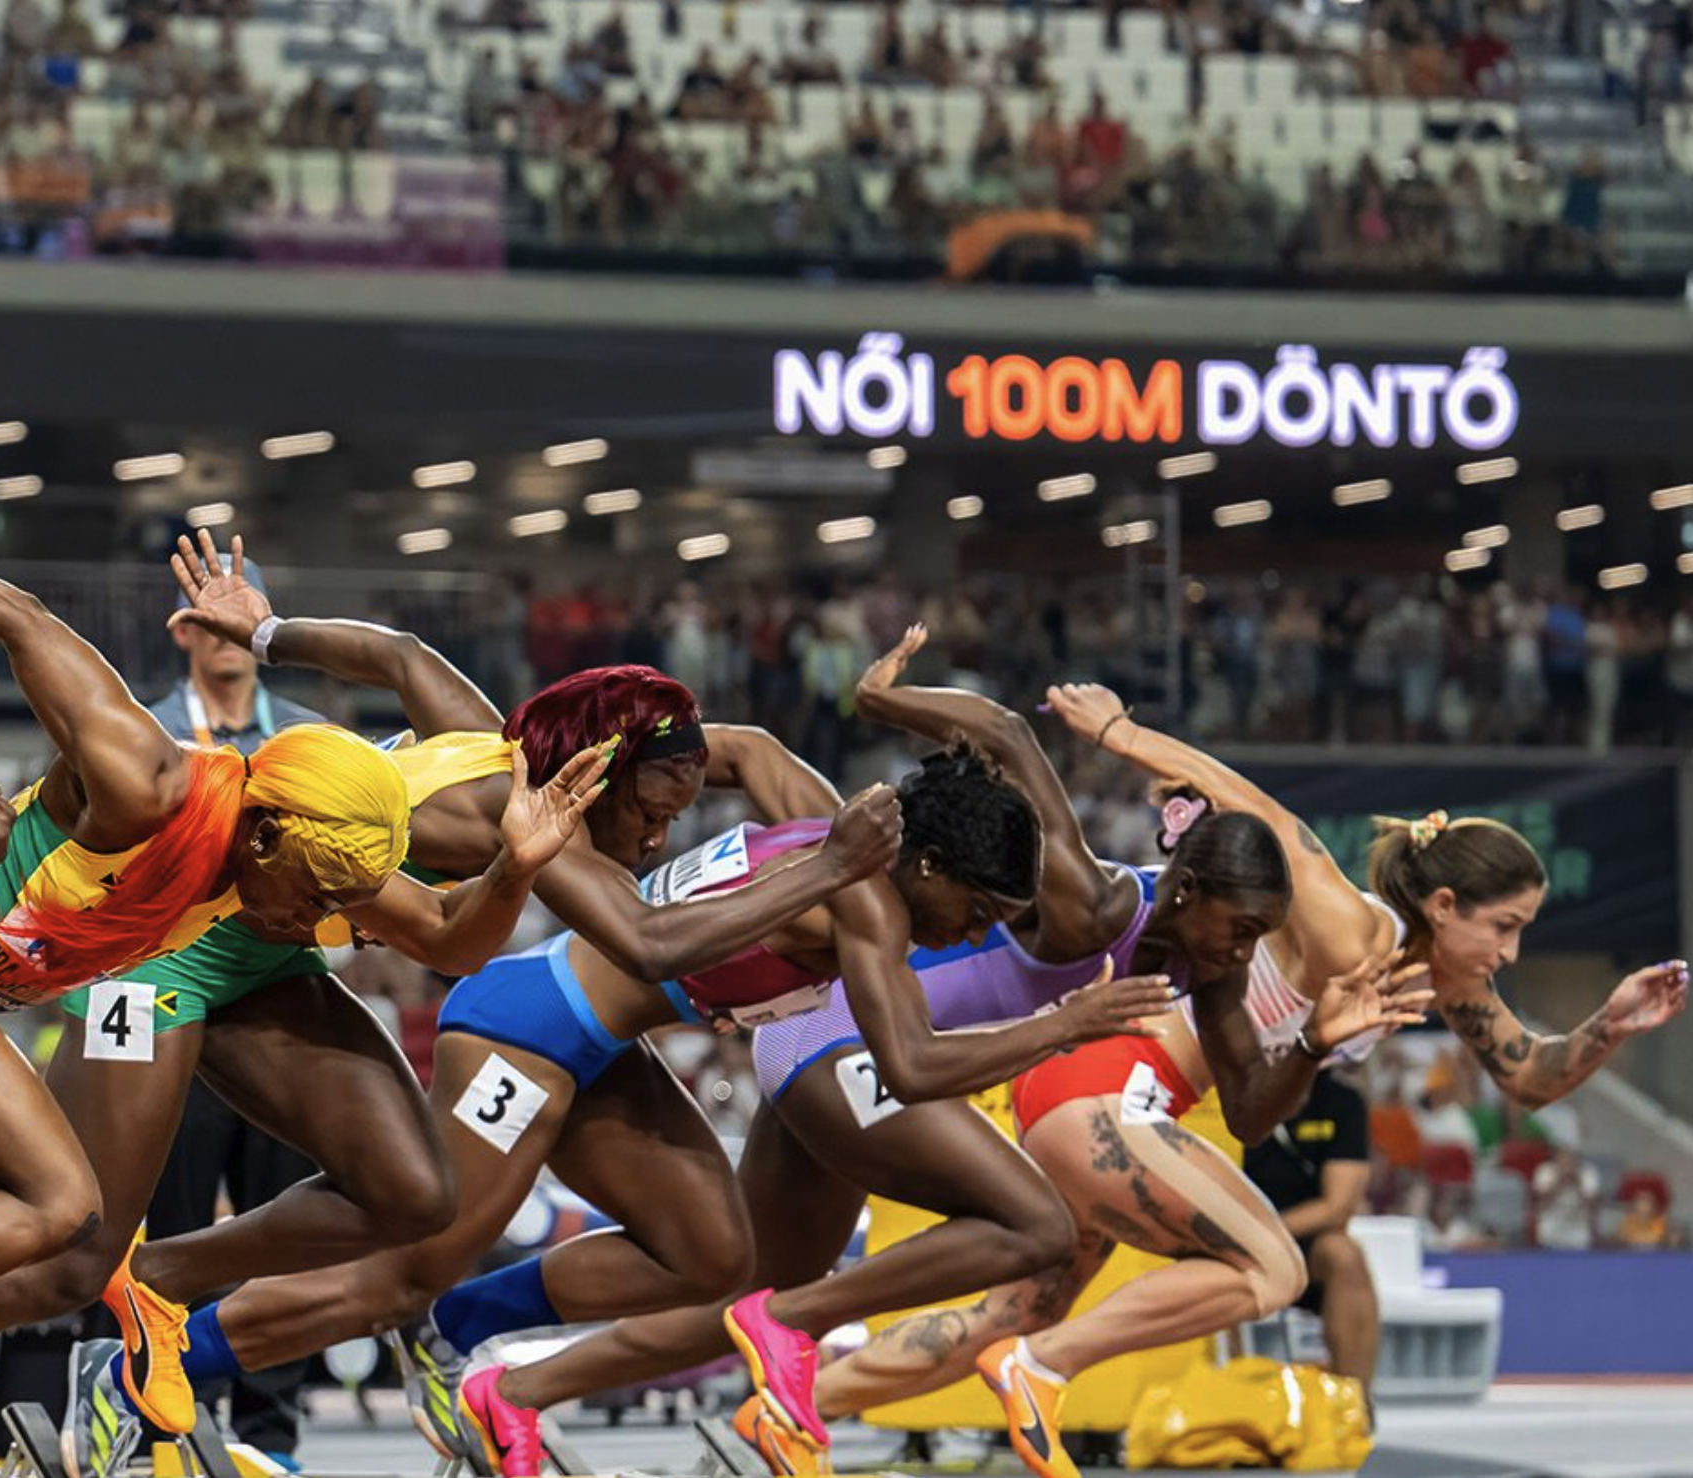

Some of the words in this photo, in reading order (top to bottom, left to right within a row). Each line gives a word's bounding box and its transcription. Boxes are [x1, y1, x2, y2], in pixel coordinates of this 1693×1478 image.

[774, 331, 935, 438] NŐI
[948, 355, 1183, 443] 100M
[1197, 344, 1520, 450] DÖNTŐ
[101, 995, 132, 1047] 4
[477, 1076, 517, 1124] 3
